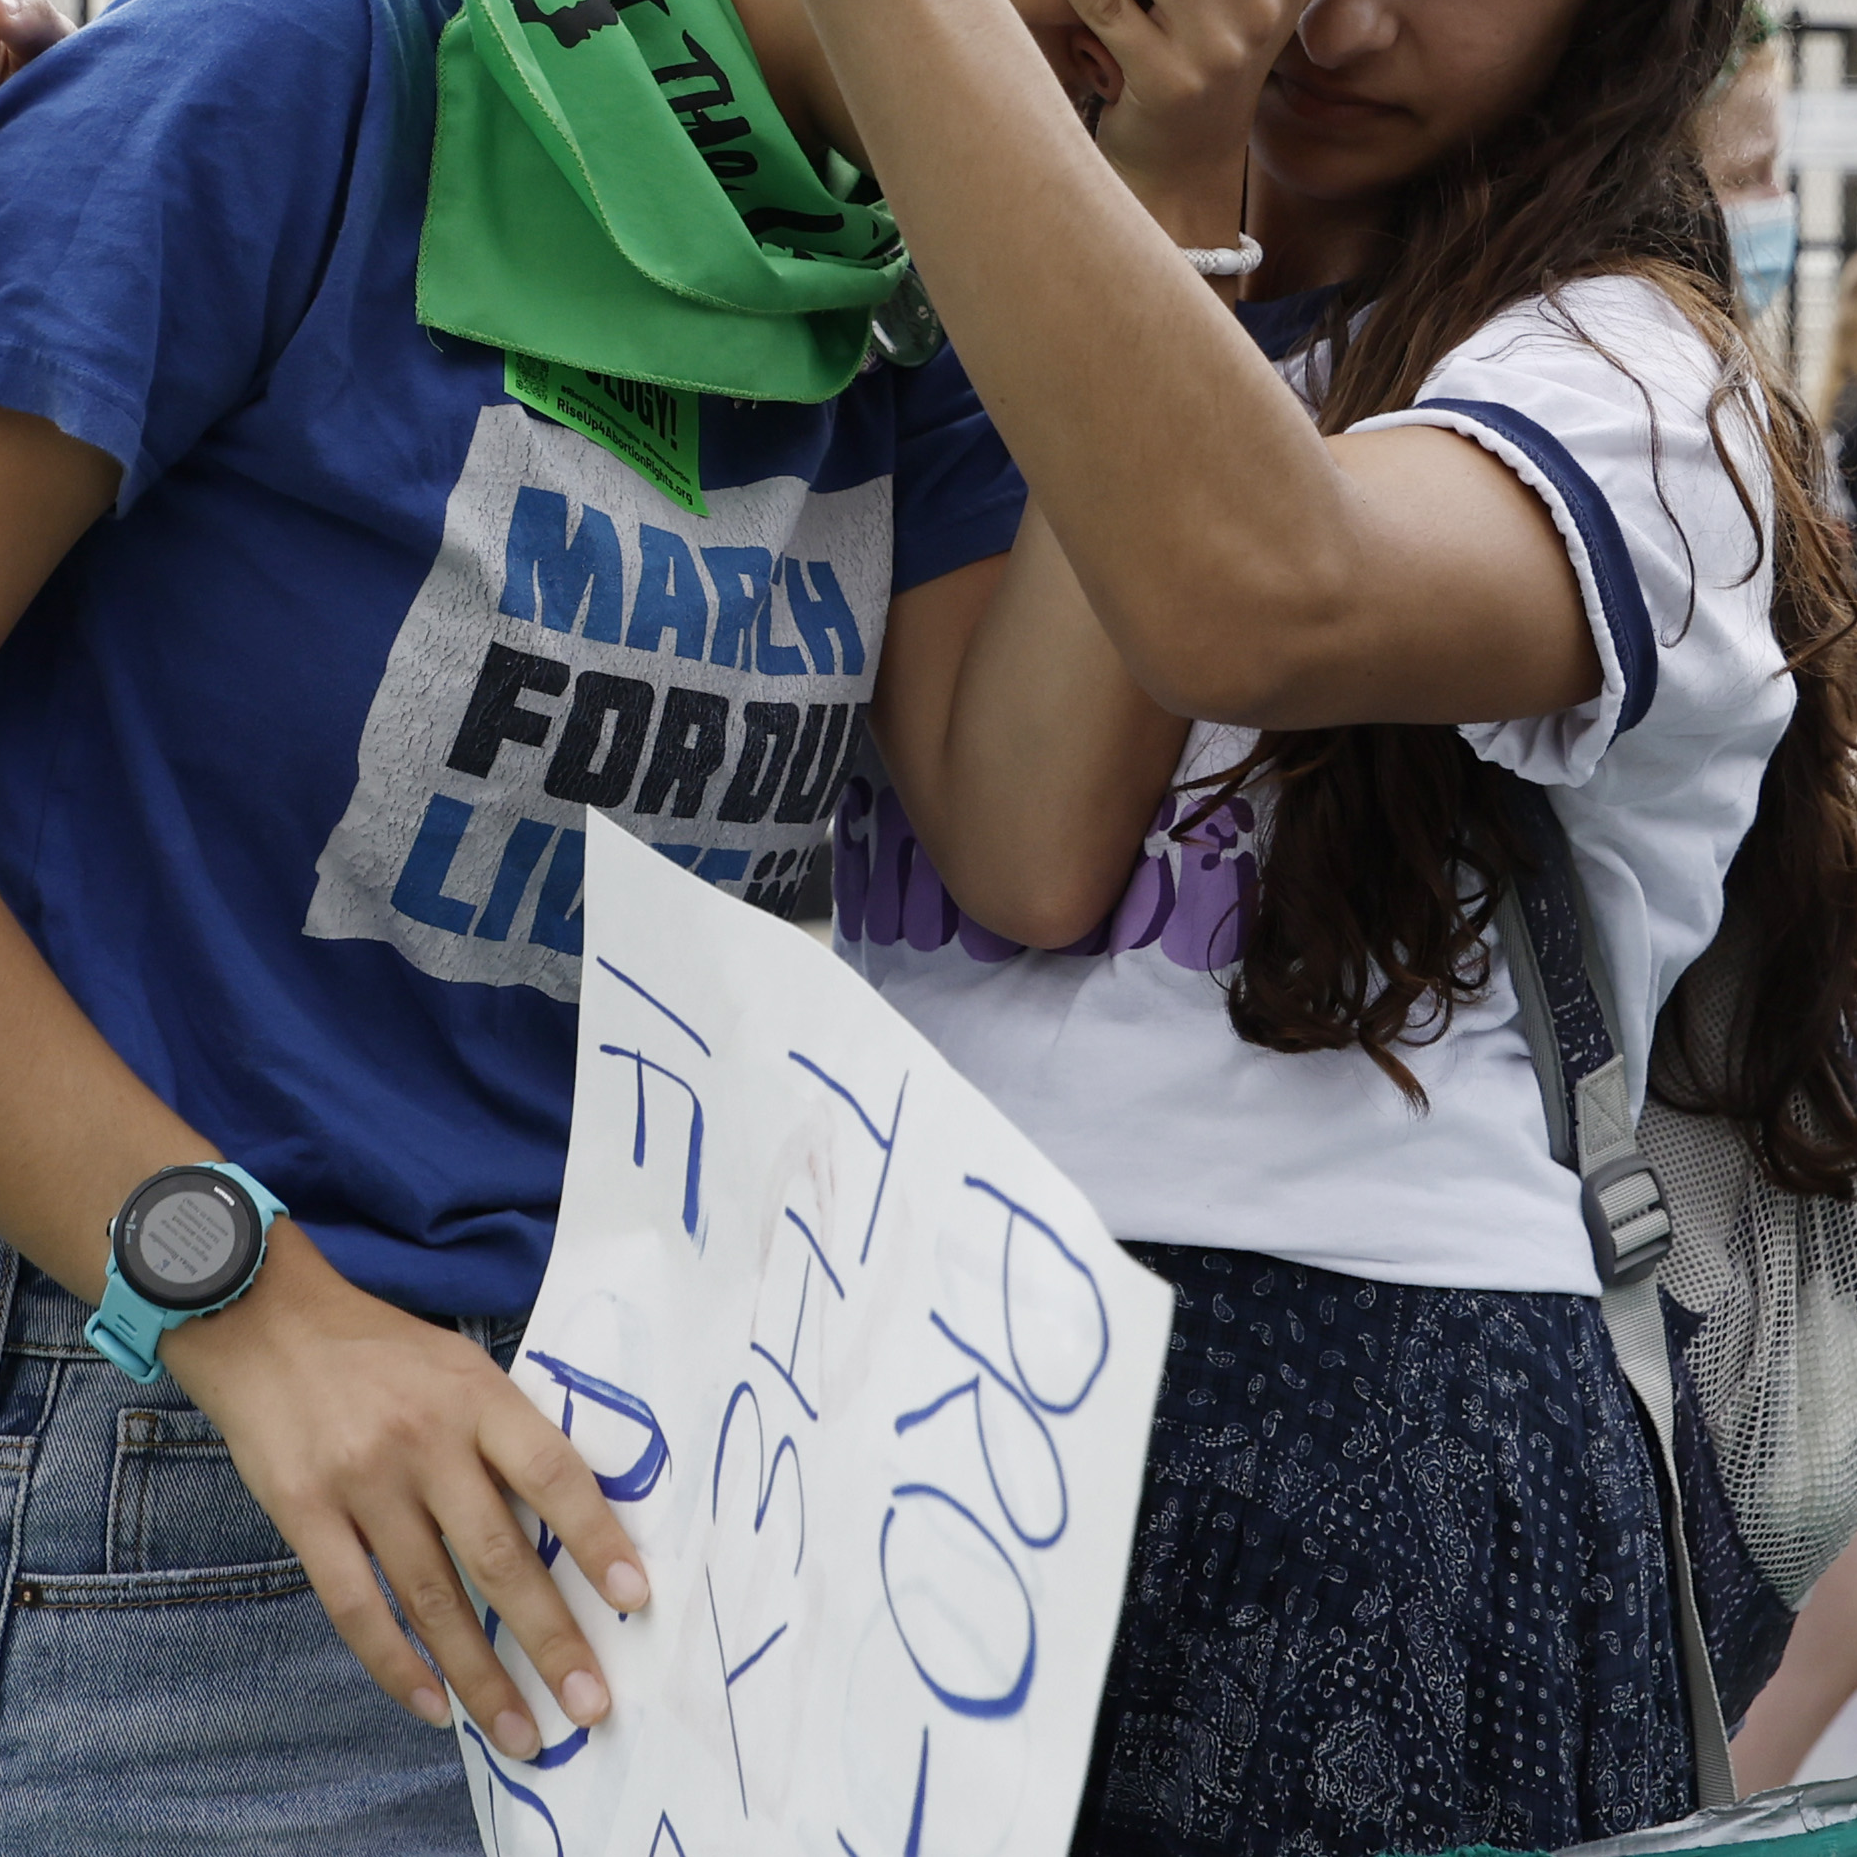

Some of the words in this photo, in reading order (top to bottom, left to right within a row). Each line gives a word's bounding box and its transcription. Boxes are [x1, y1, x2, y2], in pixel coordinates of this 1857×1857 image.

[556, 397, 694, 506] RiseUp4AbortionRights.org
[498, 484, 866, 676] MARCH
[445, 640, 730, 820] FOR
[717, 701, 873, 825] OU
[595, 956, 712, 1258] IF
